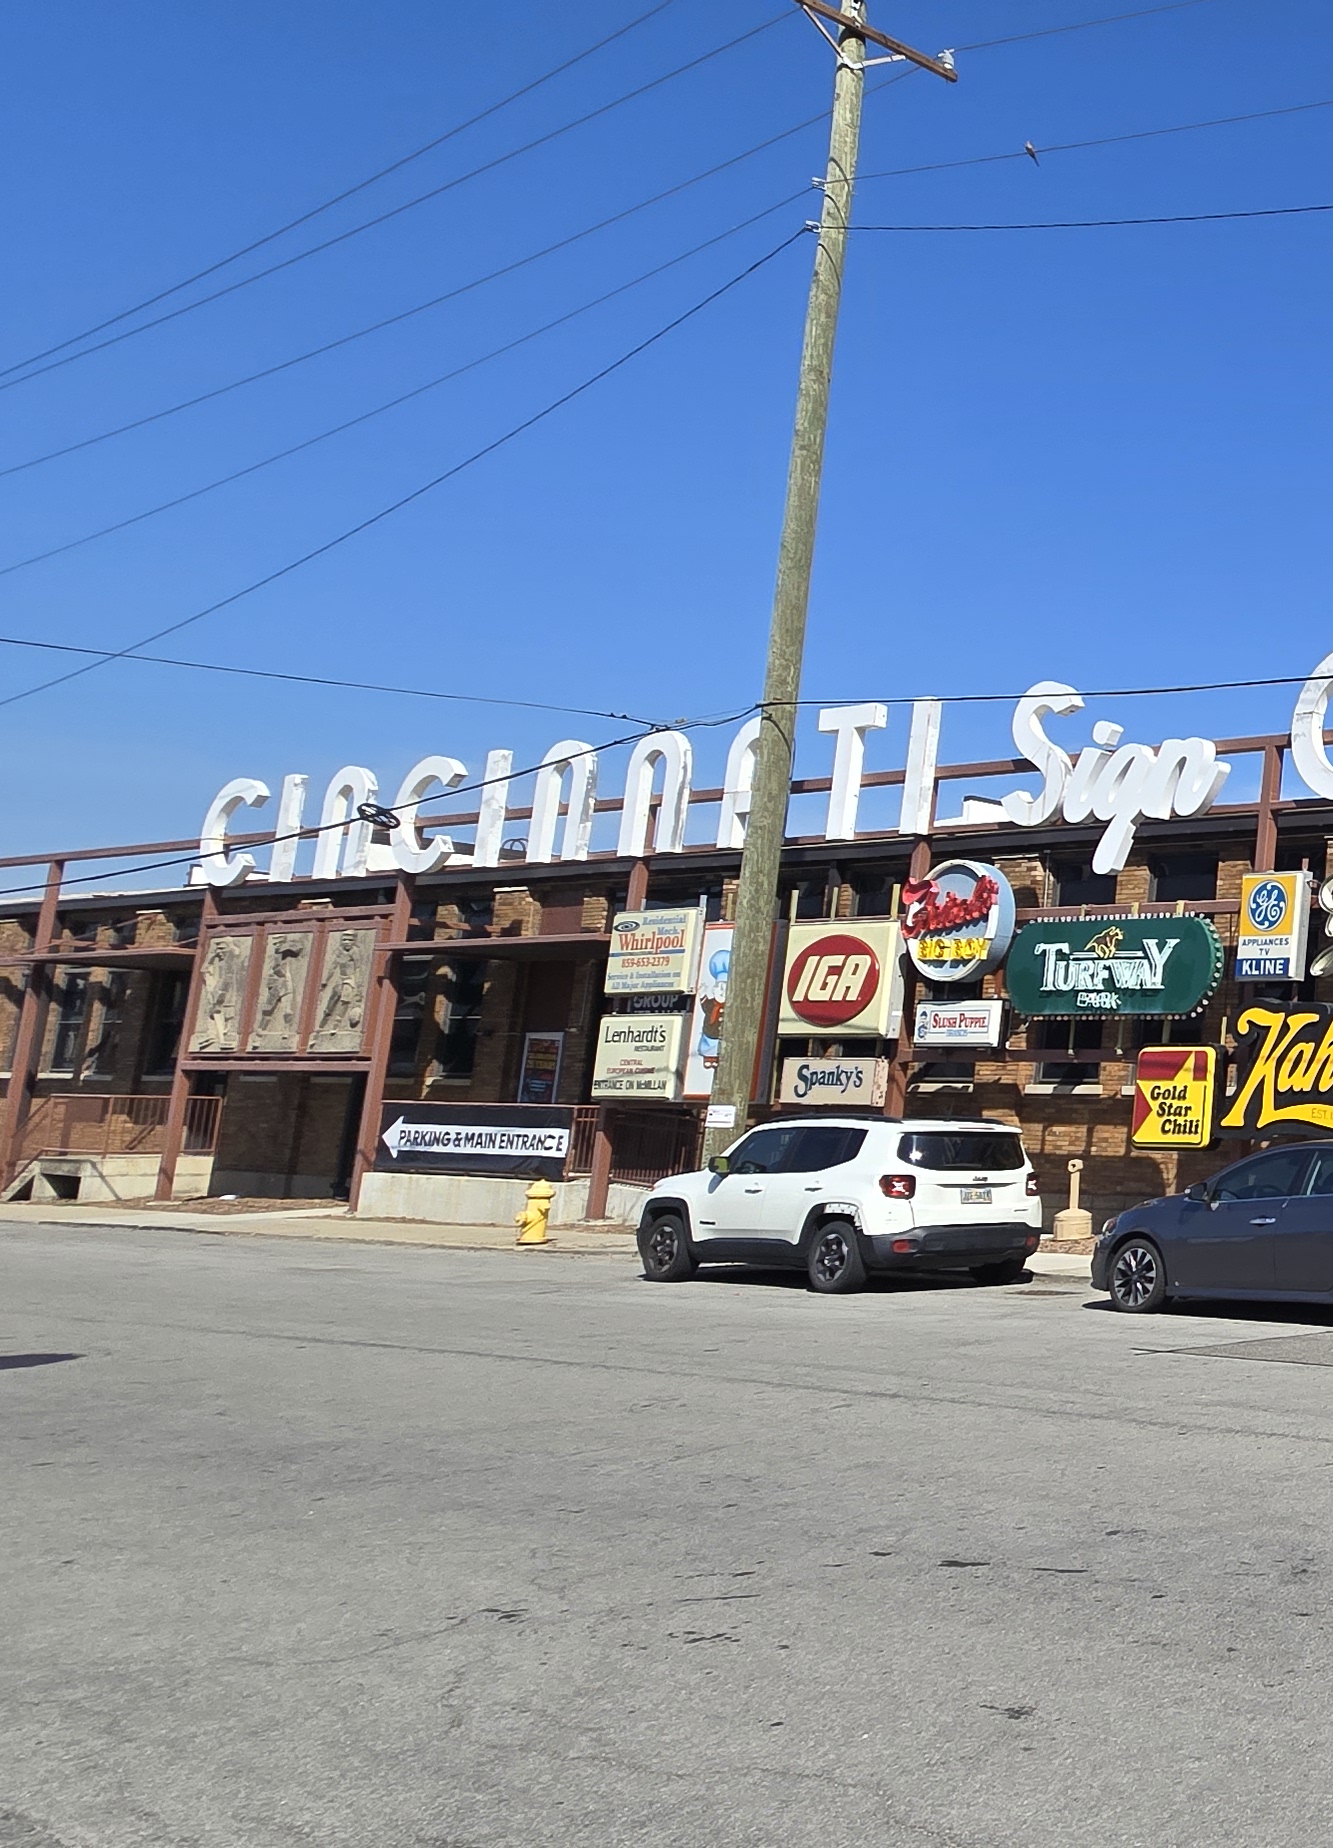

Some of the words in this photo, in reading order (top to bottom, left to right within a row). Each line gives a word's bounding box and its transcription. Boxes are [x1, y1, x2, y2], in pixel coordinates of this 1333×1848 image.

[1000, 681, 1230, 875] Sign
[618, 929, 686, 955] Whirlpool
[918, 938, 947, 960] BIG
[950, 938, 988, 960] BOY
[1242, 937, 1289, 946] APPLIANCES
[1259, 948, 1270, 956] TV
[1034, 938, 1181, 991] TURFWAY
[1242, 959, 1285, 976] KLINE
[792, 954, 872, 1001] IGA
[932, 1013, 957, 1028] SLUSH
[604, 1024, 666, 1043] Lenhardt's
[593, 1080, 624, 1090] ENTRANCE
[625, 1080, 635, 1090] ON
[794, 1063, 864, 1098] Spanky's
[1150, 1084, 1188, 1101] Gold
[1156, 1101, 1192, 1118] Star
[1311, 1108, 1328, 1120] EST.
[1160, 1118, 1200, 1135] Chili
[399, 1129, 452, 1147] PARKING
[453, 1132, 463, 1148] &
[463, 1132, 498, 1149] MAIN
[498, 1133, 564, 1151] ENTRANCE
